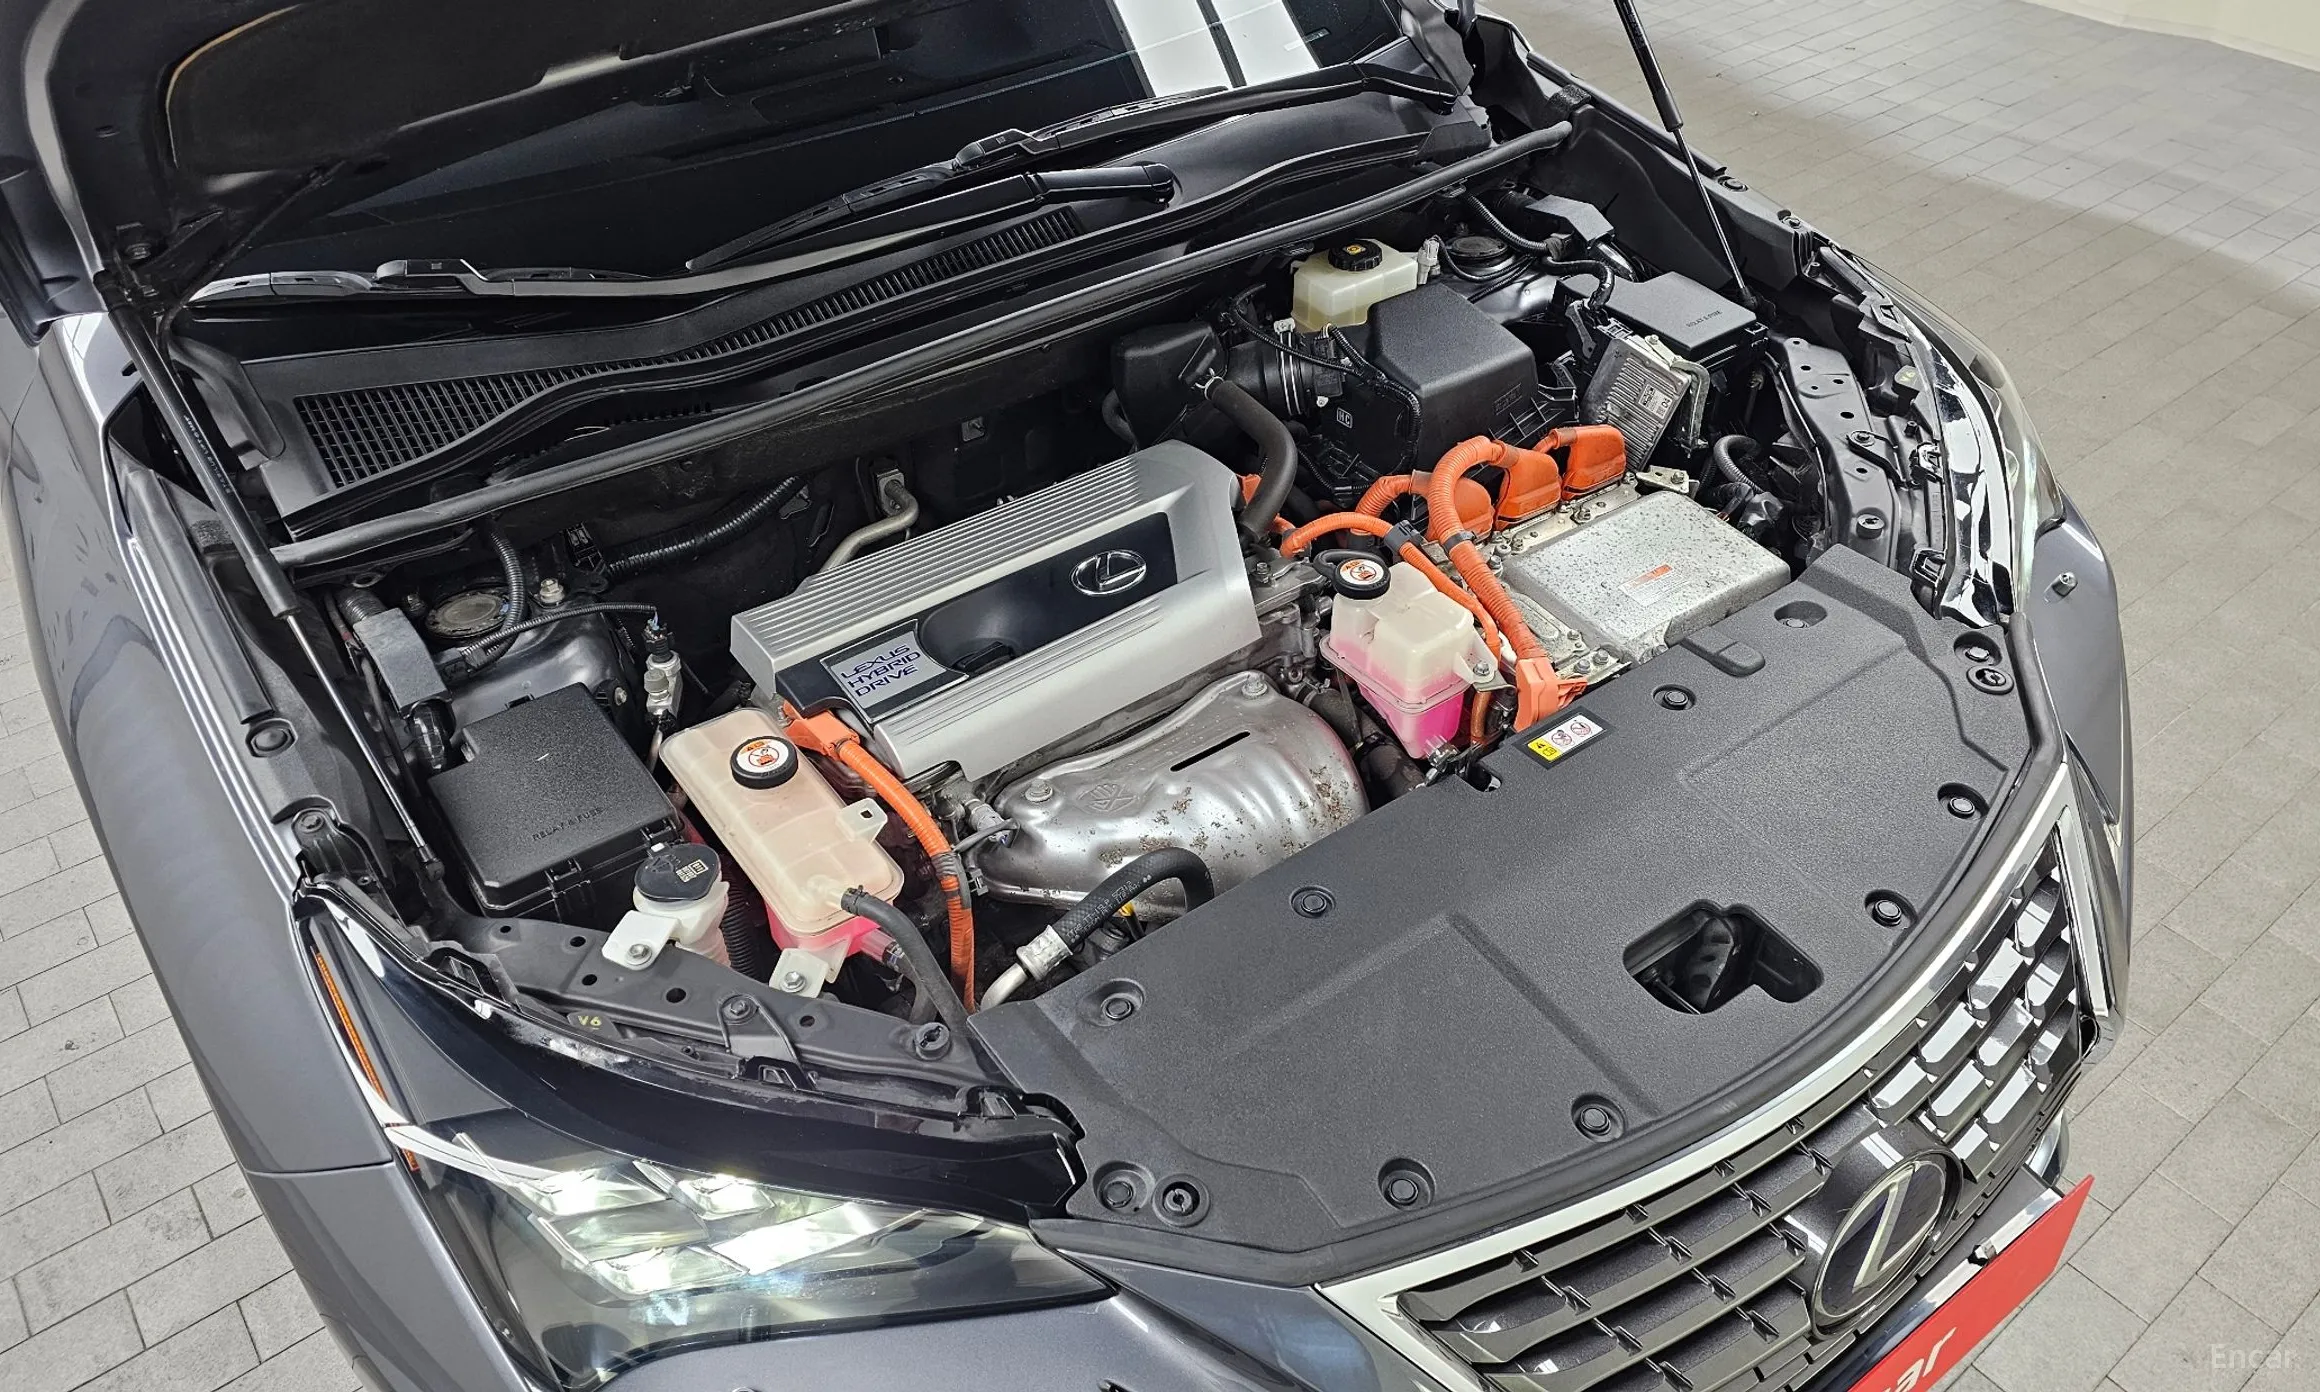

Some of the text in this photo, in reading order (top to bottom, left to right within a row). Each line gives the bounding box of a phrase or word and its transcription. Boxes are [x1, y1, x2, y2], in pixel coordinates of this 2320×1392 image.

[1338, 410, 1351, 426] HC
[840, 644, 910, 679] LEXUS
[847, 651, 921, 688] HYBRID
[855, 664, 918, 697] DRIVE
[531, 821, 564, 842] RELAY
[577, 1015, 602, 1026] V6
[1882, 1326, 1958, 1392] ar
